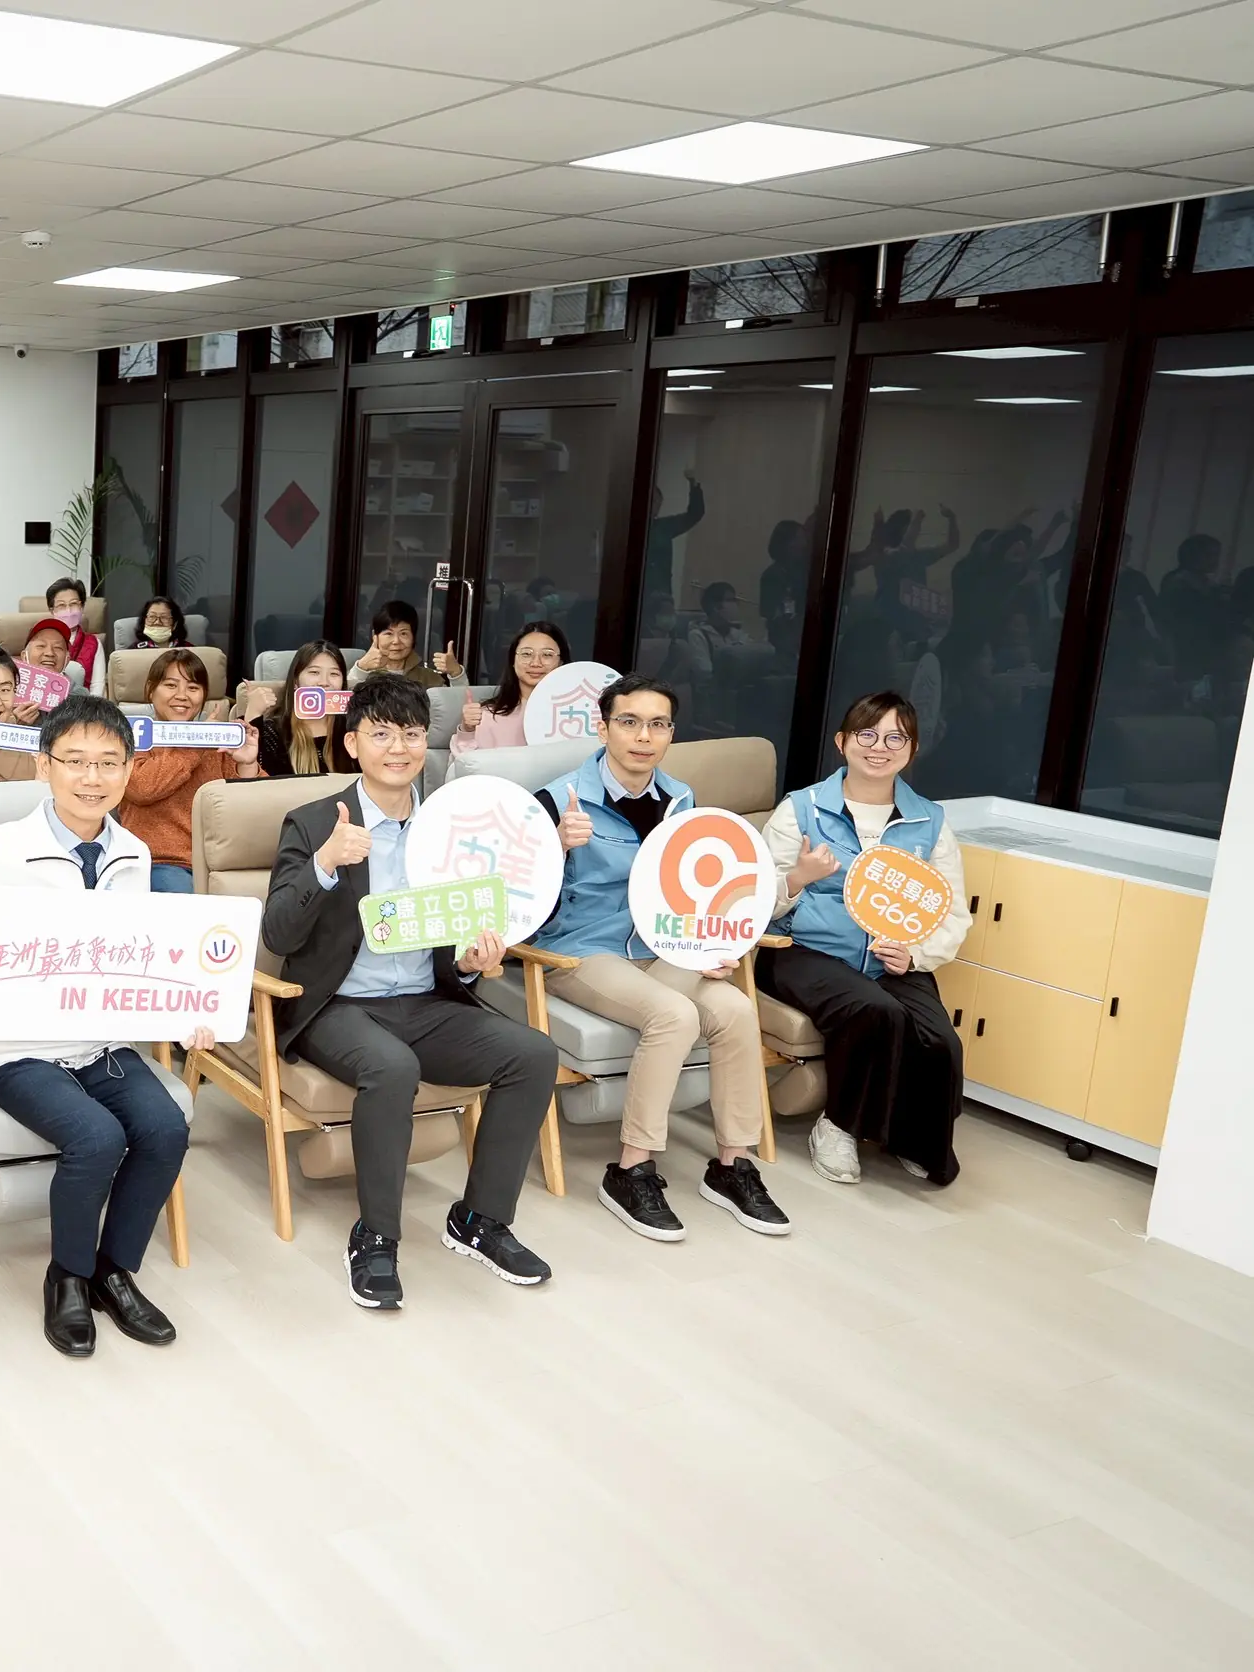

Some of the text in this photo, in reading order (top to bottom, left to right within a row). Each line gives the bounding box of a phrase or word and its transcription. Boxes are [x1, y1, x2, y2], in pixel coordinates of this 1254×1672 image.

[397, 887, 494, 920] 康立日間
[855, 884, 923, 934] 1966
[399, 911, 496, 943] 照顧中心
[654, 913, 754, 941] KEELUNG
[653, 940, 702, 951] A city full of
[60, 987, 219, 1012] IN KEELUNG
